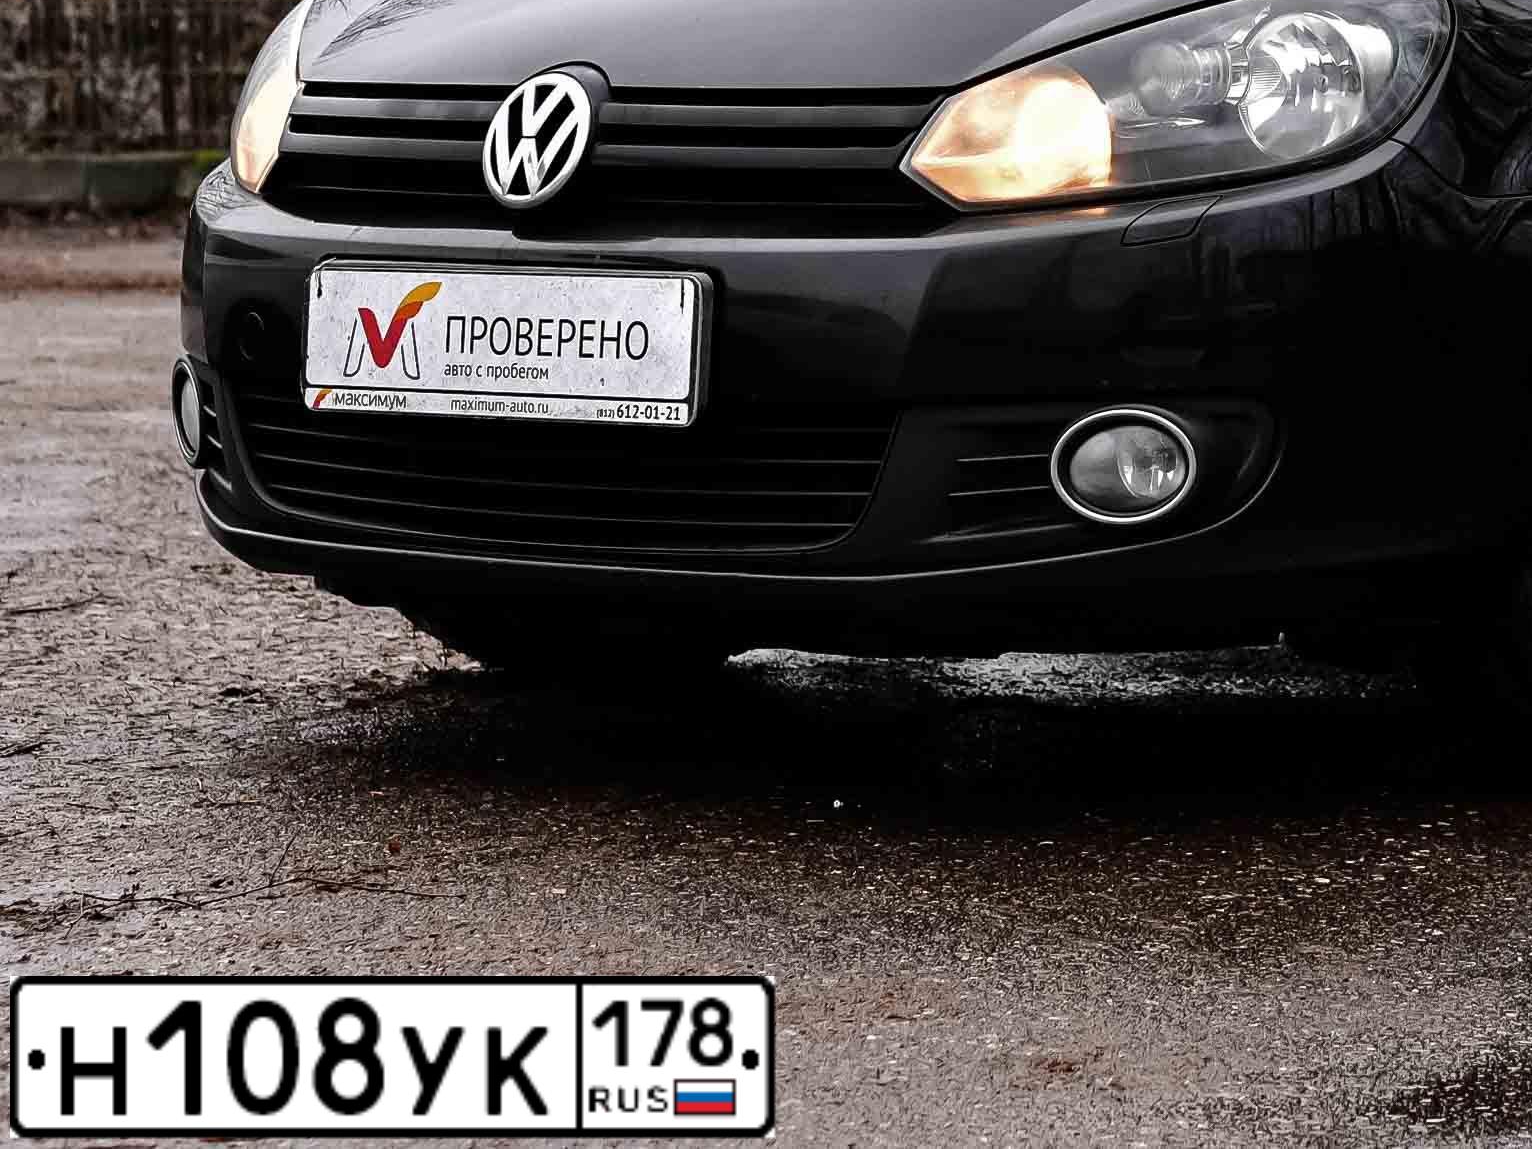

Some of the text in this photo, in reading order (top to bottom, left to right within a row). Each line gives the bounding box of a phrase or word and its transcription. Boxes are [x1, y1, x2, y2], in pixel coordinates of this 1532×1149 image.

[444, 315, 650, 361] ПРОВЕРЕНО
[443, 362, 550, 382] авто с пробегом
[334, 392, 407, 410] максимум
[450, 396, 550, 414] maximum-auto.ru
[595, 403, 681, 421] (812) 612-01-21
